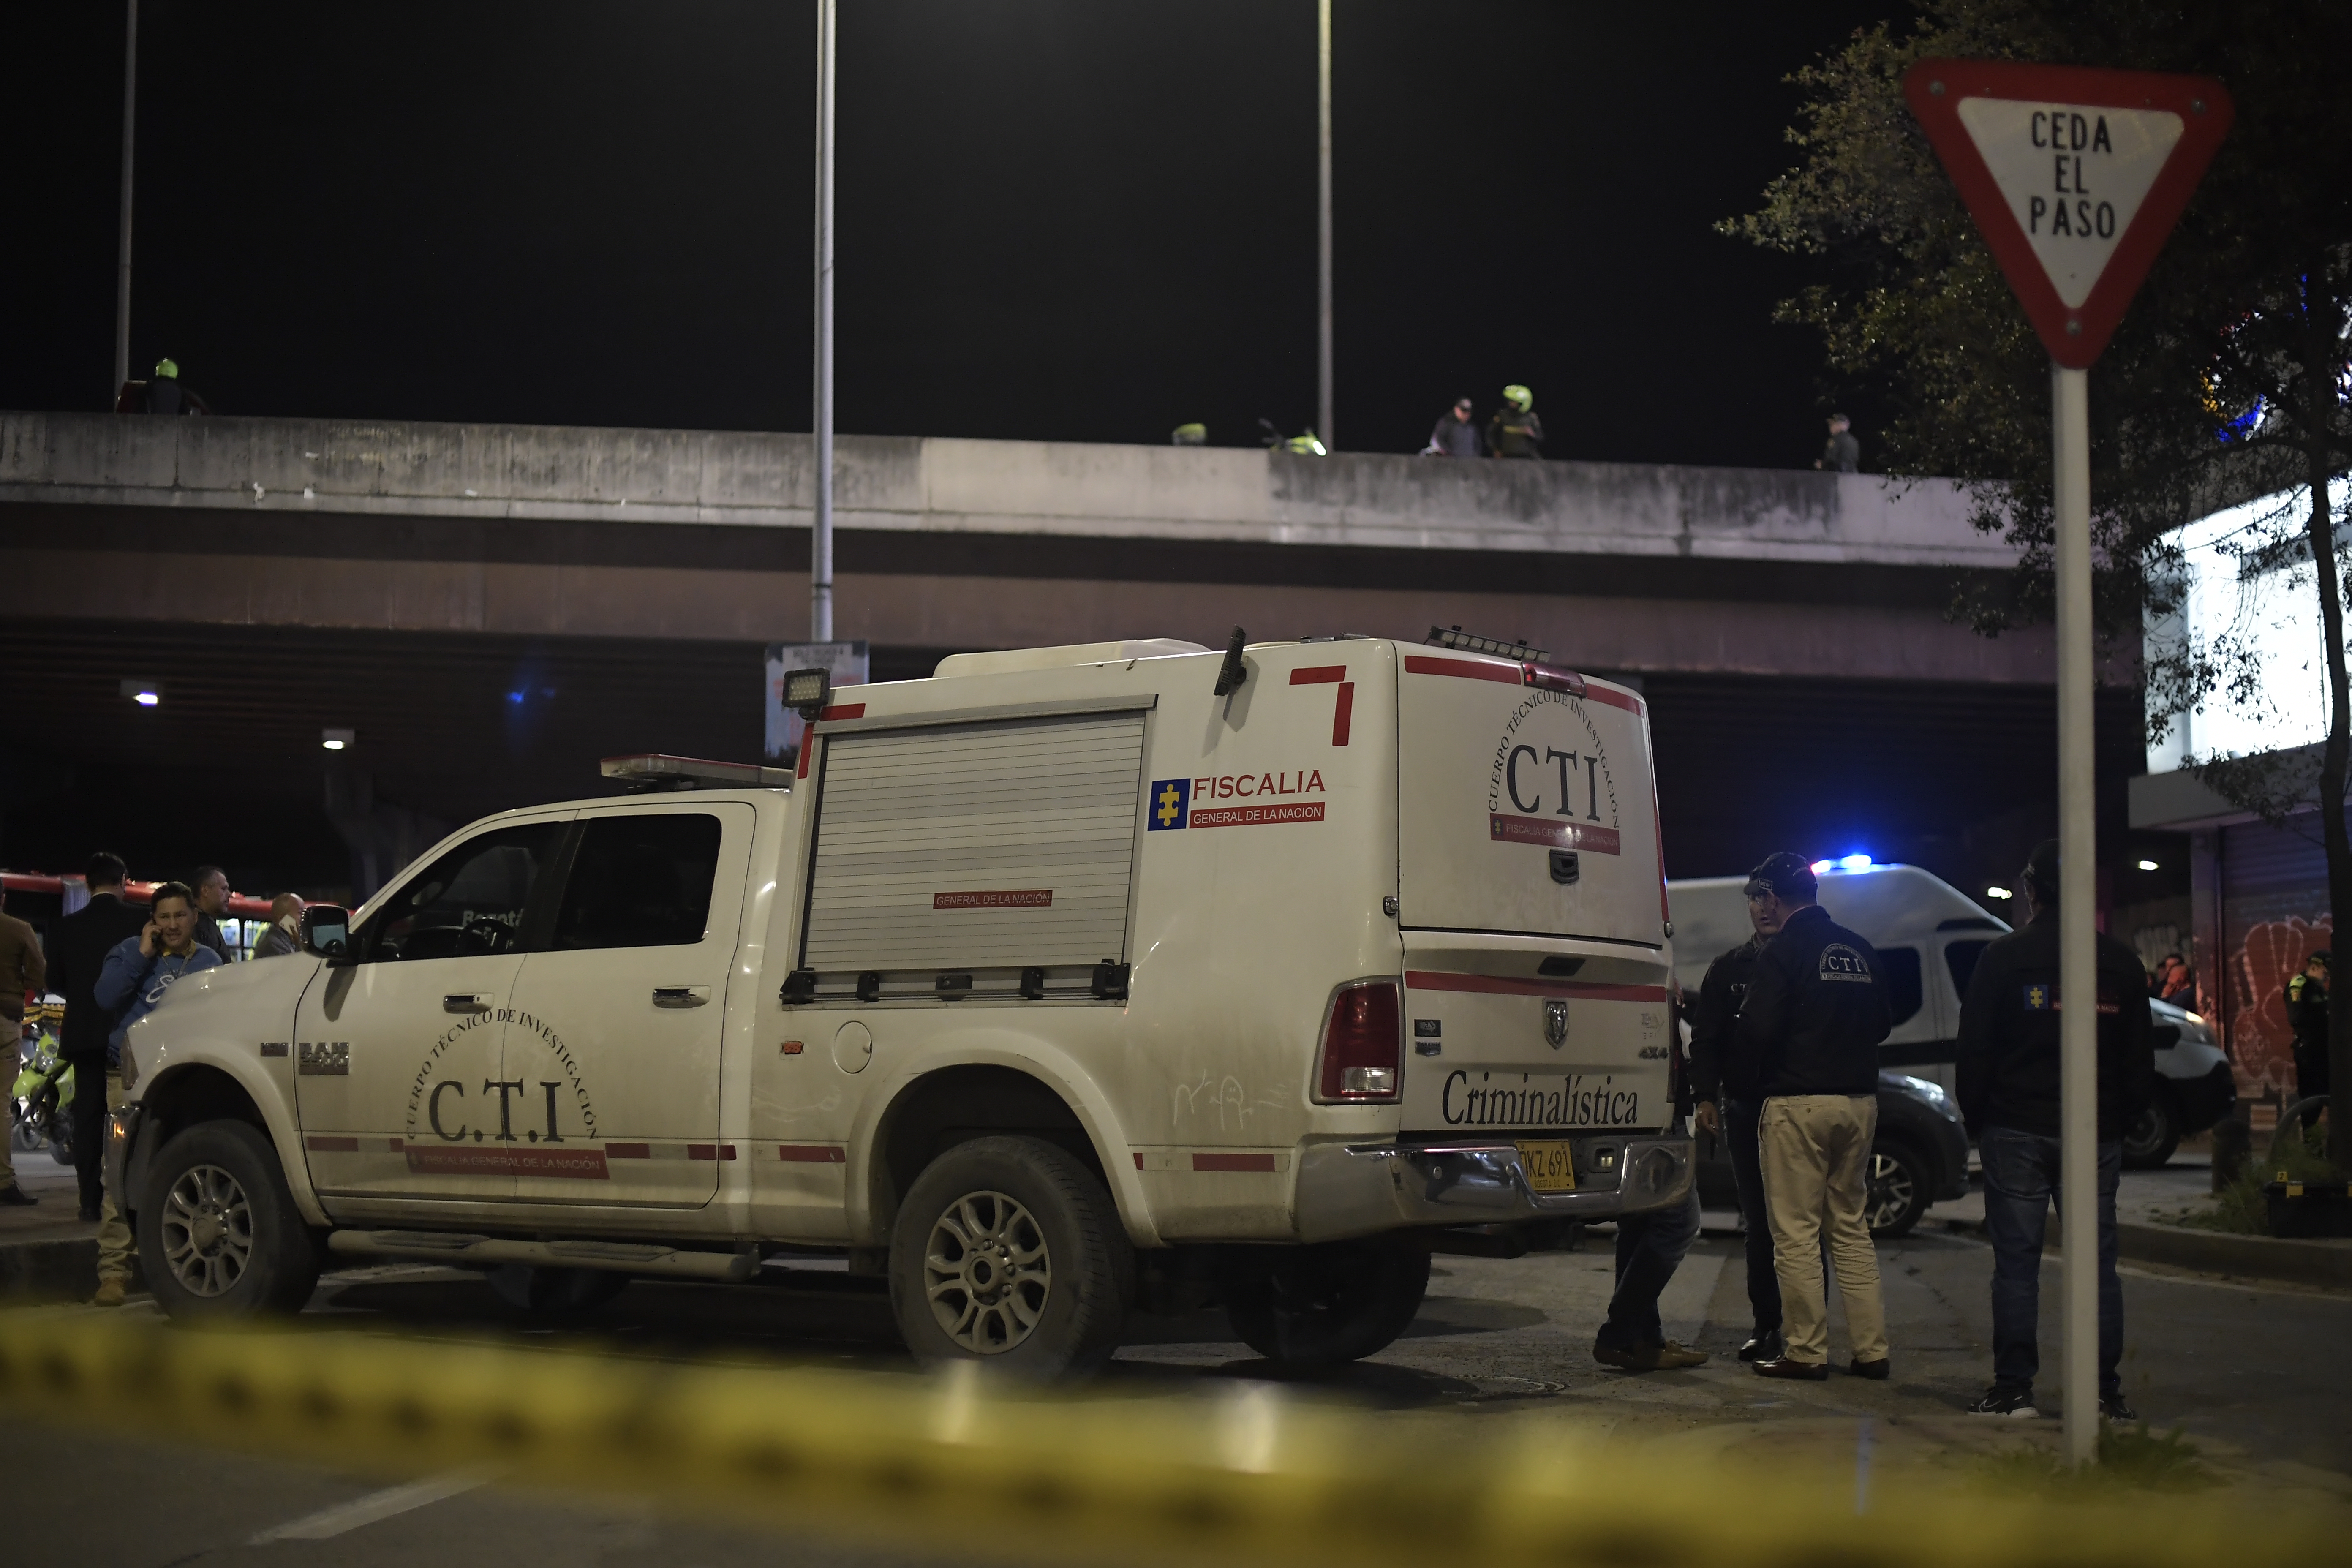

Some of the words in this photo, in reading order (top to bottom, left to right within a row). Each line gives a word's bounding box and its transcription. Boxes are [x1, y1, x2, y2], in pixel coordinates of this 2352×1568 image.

[2031, 110, 2112, 154] CEDA
[2055, 155, 2090, 195] EL
[2030, 196, 2116, 240] PASO
[1489, 735, 1510, 812] CUERPO
[1506, 689, 1551, 735] TÉCNICO
[1554, 691, 1568, 707] DE
[1569, 698, 1620, 829] INVESTIGACIÓN
[1193, 770, 1326, 800] FISCALIA
[1506, 744, 1601, 822] CTI
[1193, 811, 1243, 824] GENERAL
[1246, 810, 1260, 821] DE
[1263, 809, 1276, 820] LA
[1279, 806, 1322, 819] NACION
[1587, 833, 1595, 842] LA
[936, 895, 980, 906] GENERAL
[983, 895, 996, 904] DE
[999, 894, 1011, 904] LA
[1013, 893, 1050, 904] NACIÓN
[1828, 956, 1862, 972] CTI
[1731, 983, 1747, 992] CT
[406, 1060, 432, 1140] CUERPO
[430, 1009, 493, 1058] TÉCNICO
[496, 1008, 516, 1023] DE
[519, 1012, 599, 1140] INVESTIGACIÓN
[428, 1078, 565, 1143] C.T.I
[1442, 1069, 1638, 1126] Criminalística
[471, 1156, 520, 1167] GENERAL
[523, 1157, 538, 1167] DE
[542, 1158, 555, 1168] LA
[556, 1156, 600, 1170] NACIÓN
[1548, 1150, 1571, 1177] 691
